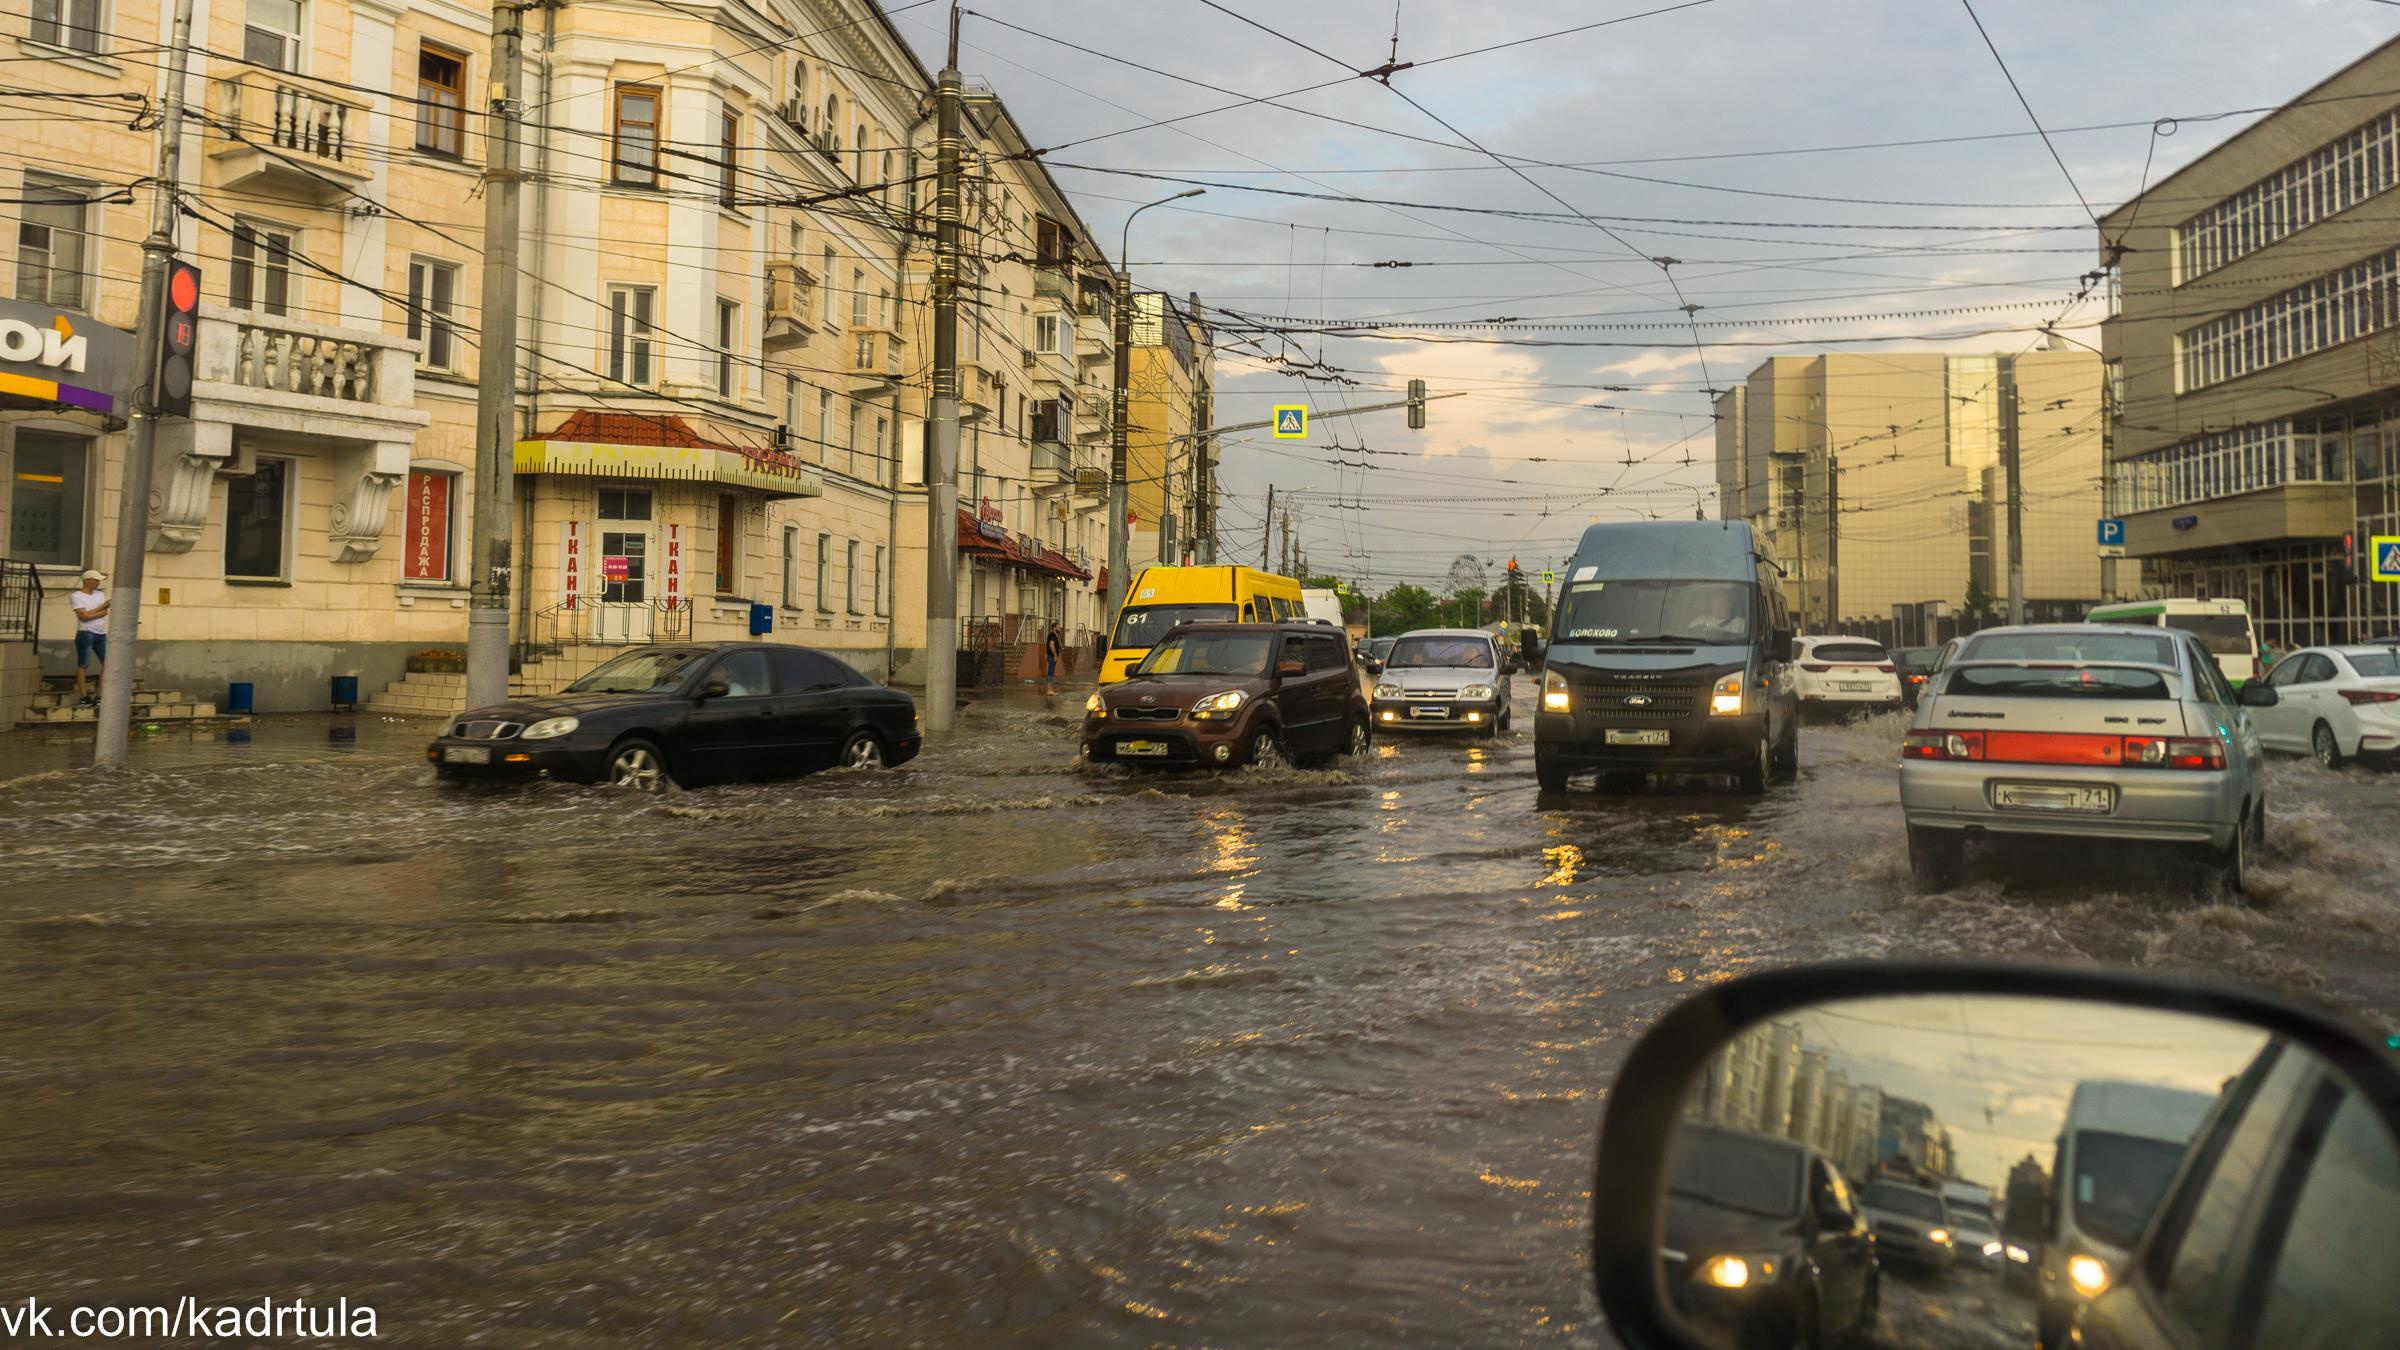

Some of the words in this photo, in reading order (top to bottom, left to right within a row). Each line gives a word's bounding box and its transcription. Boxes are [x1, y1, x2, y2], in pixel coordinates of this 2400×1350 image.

[418, 475, 431, 577] РАСПРОДАЖА
[2104, 522, 2118, 542] P
[566, 521, 579, 609] ТКАНИ
[667, 523, 679, 610] ТКАНИ
[1126, 612, 1148, 625] 61
[2083, 789, 2102, 803] 71
